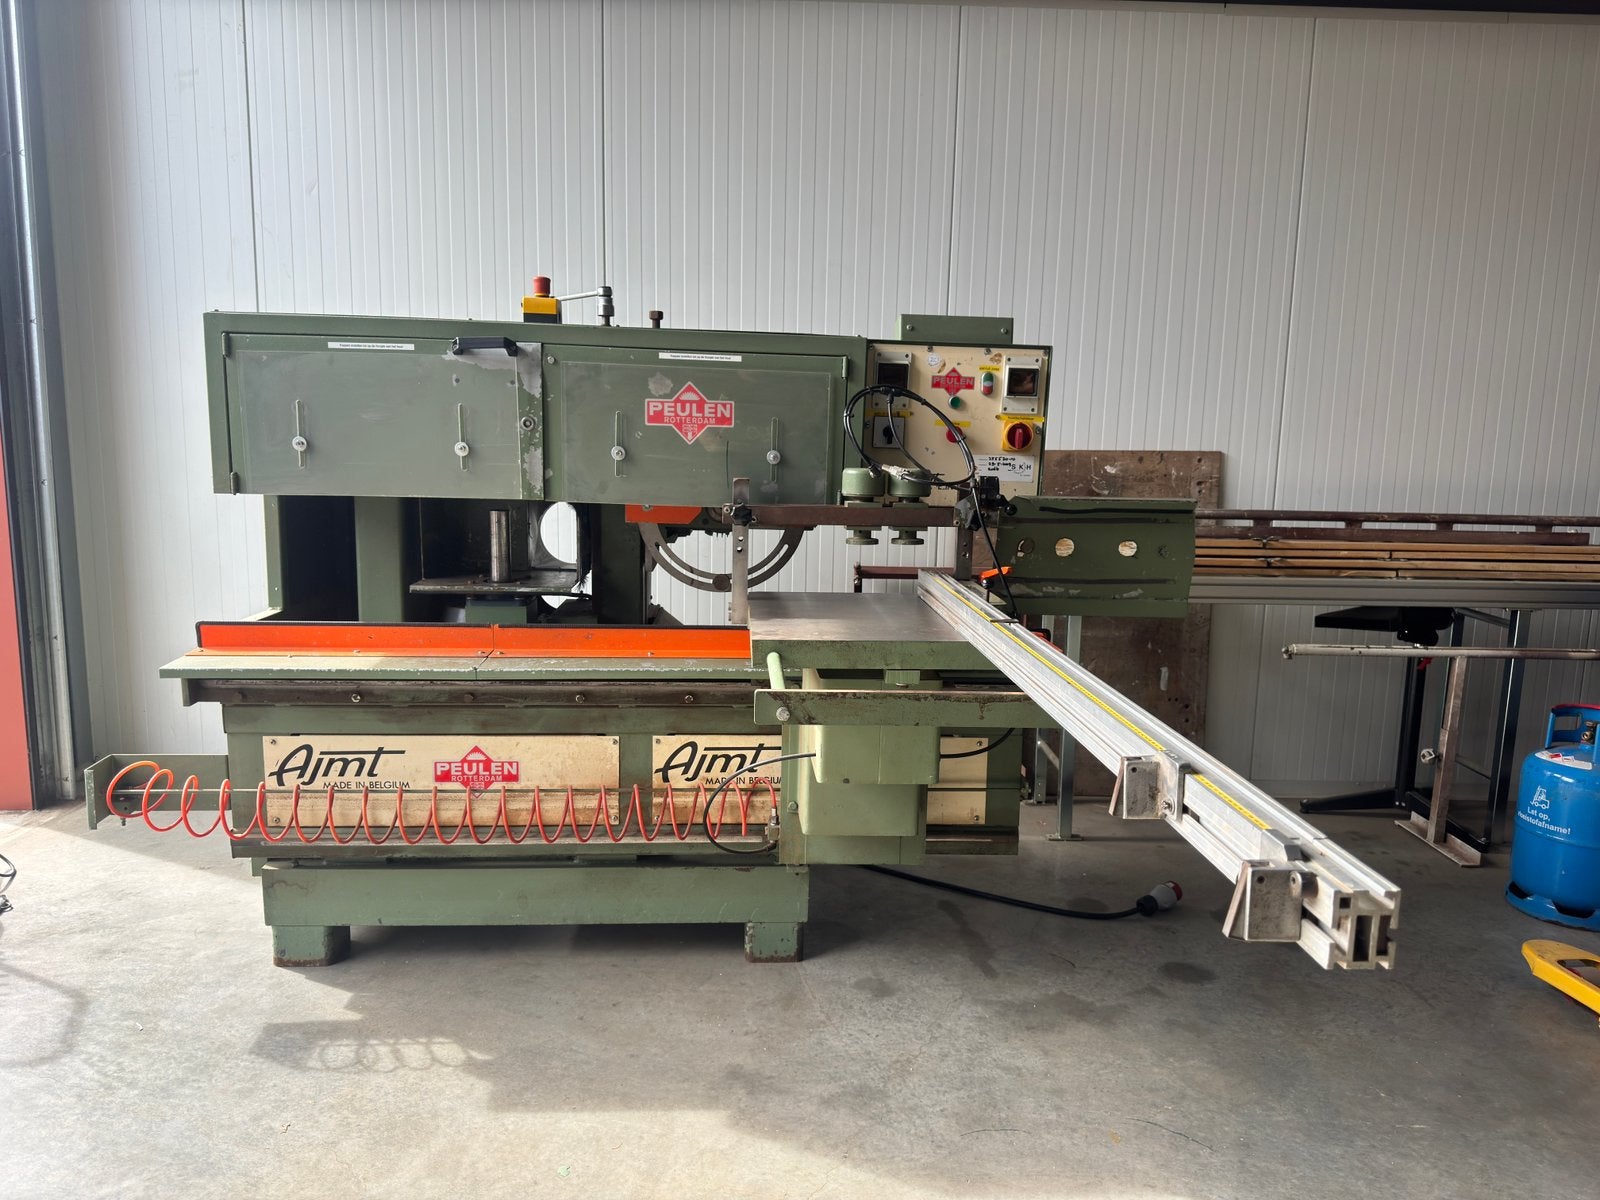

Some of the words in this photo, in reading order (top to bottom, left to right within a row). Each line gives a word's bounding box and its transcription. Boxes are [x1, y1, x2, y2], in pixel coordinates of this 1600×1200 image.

[933, 376, 974, 386] PEULEN
[648, 402, 731, 417] PEULEN
[664, 416, 716, 424] ROTTERDAM
[436, 761, 518, 775] PEULEN
[322, 780, 352, 789] MADE
[355, 780, 366, 789] IN
[369, 780, 410, 789] BELGIUM
[705, 777, 731, 785] MAD
[736, 776, 746, 785] IN
[1527, 806, 1538, 816] Let
